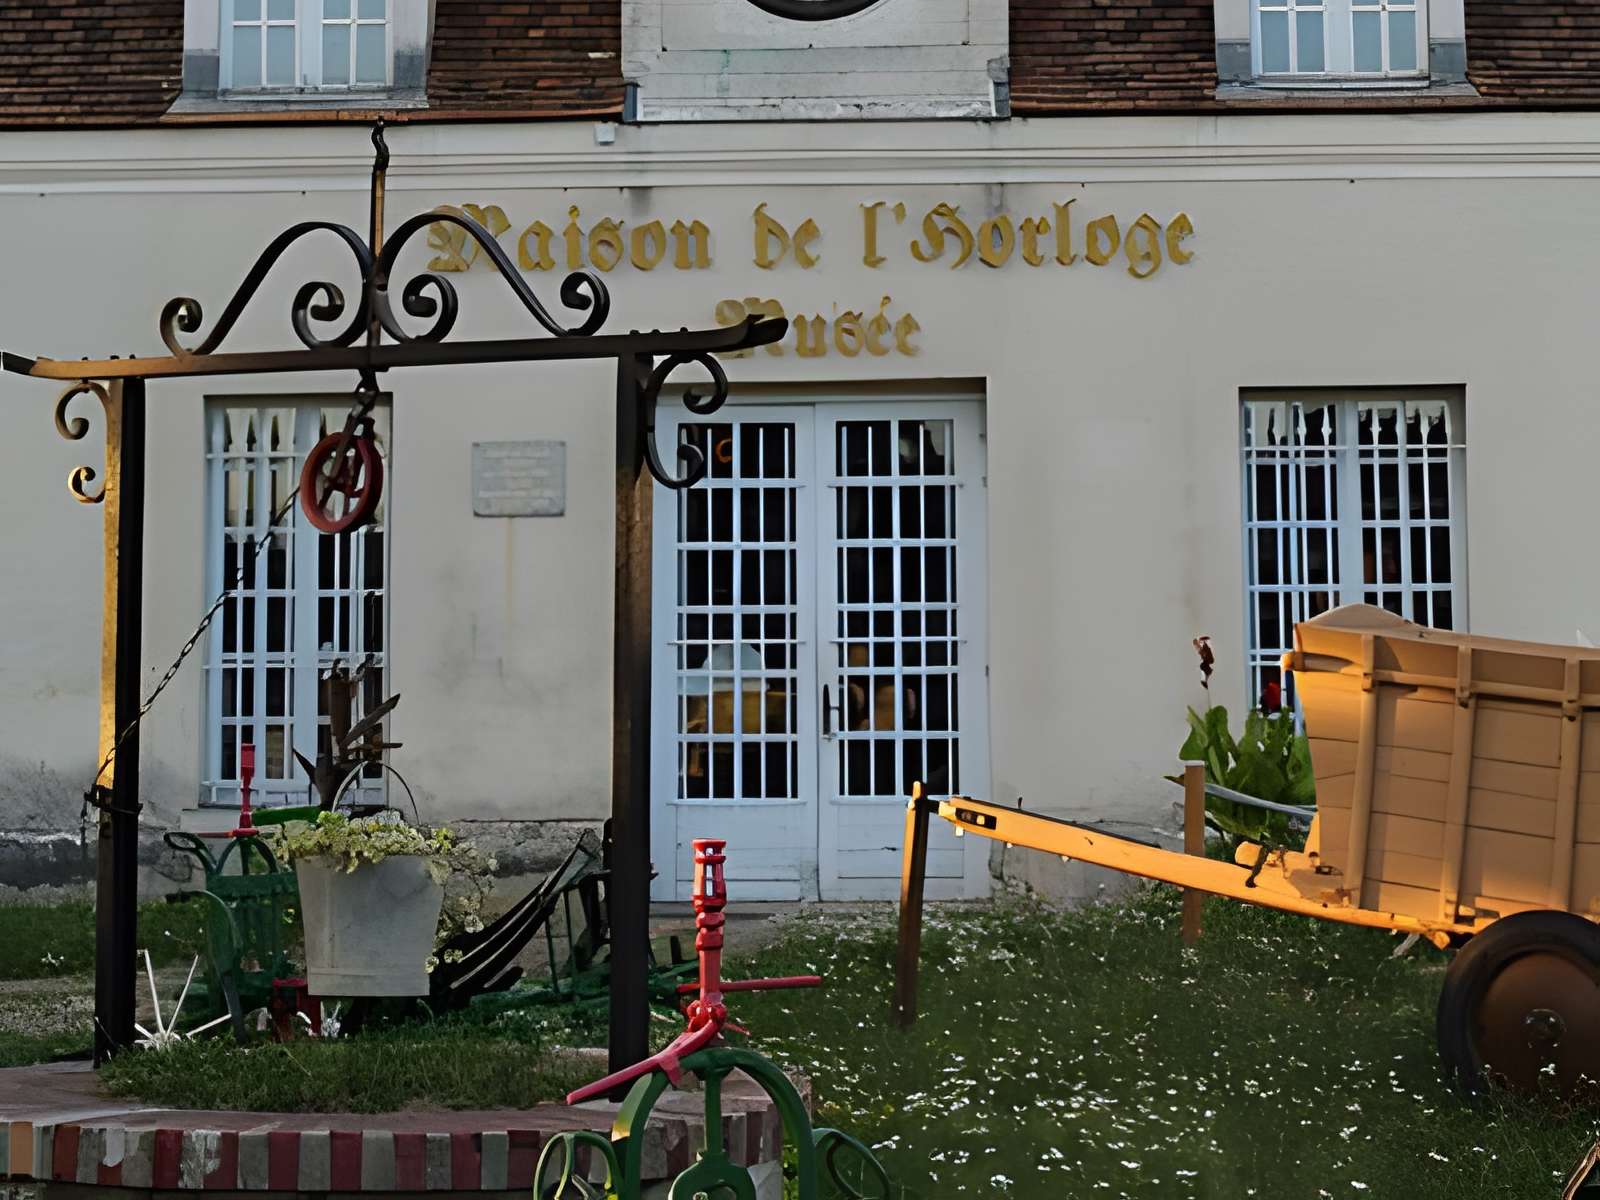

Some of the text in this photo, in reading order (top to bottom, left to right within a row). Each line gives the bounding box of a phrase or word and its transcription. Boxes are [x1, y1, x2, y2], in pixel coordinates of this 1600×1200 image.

[427, 198, 1195, 278] Maison de l'Horloge
